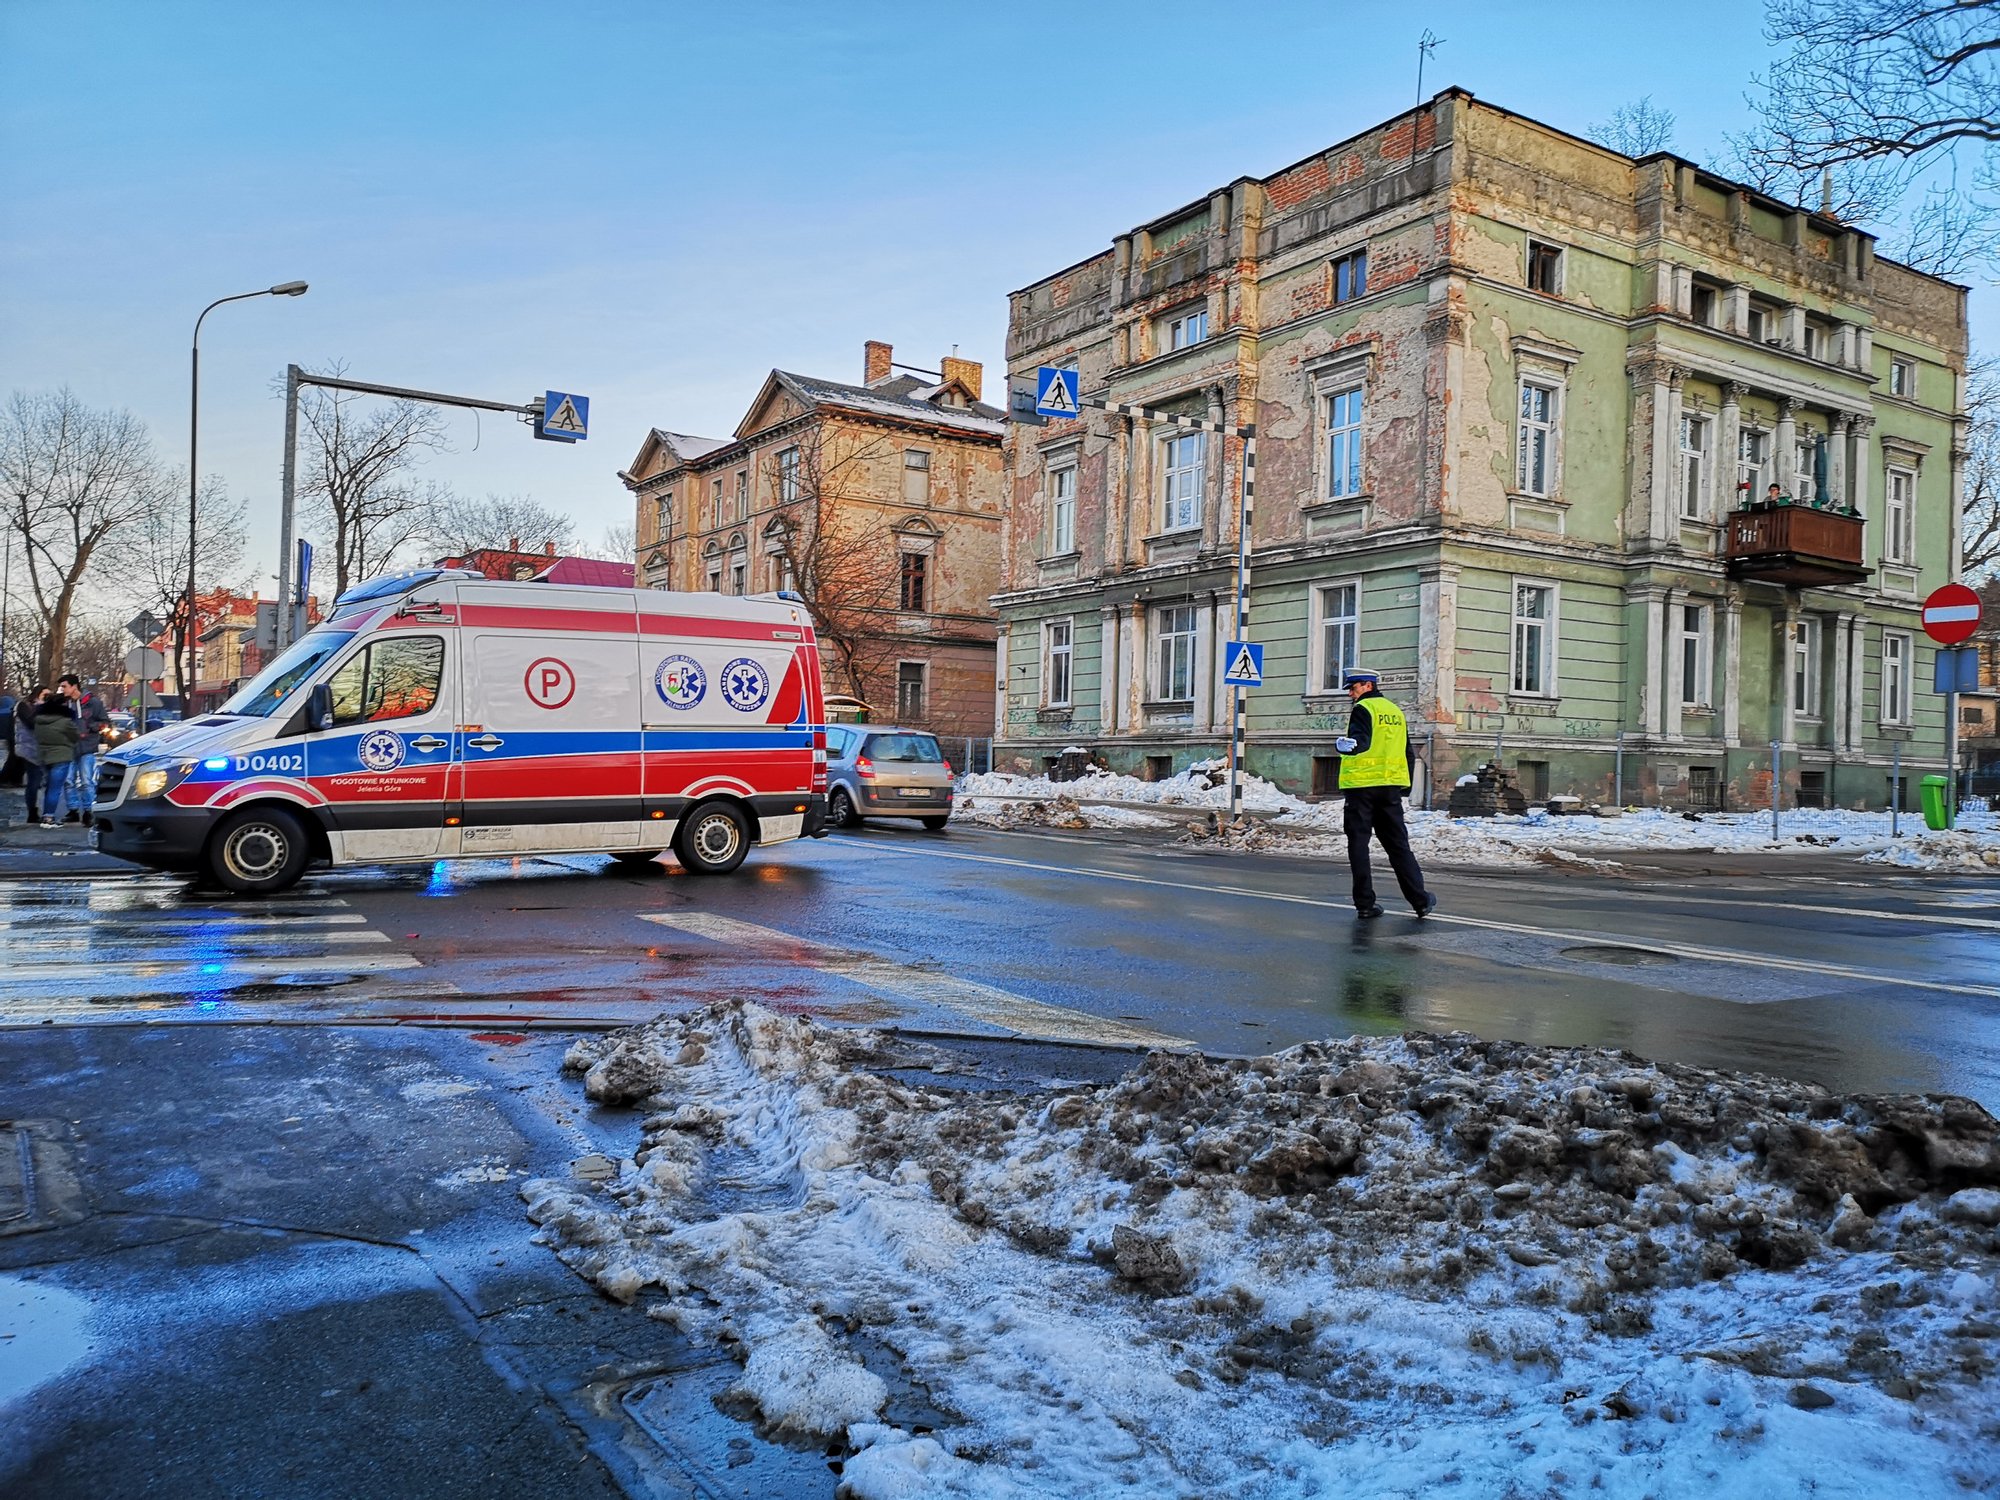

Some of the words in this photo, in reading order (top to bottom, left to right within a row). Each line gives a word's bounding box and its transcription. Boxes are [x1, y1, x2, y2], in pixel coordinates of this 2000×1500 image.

[541, 669, 561, 698] P
[730, 700, 761, 711] MEDYCZNE
[235, 755, 303, 772] DO402
[331, 777, 378, 785] POGOTOWIE
[356, 785, 383, 793] Jelenia
